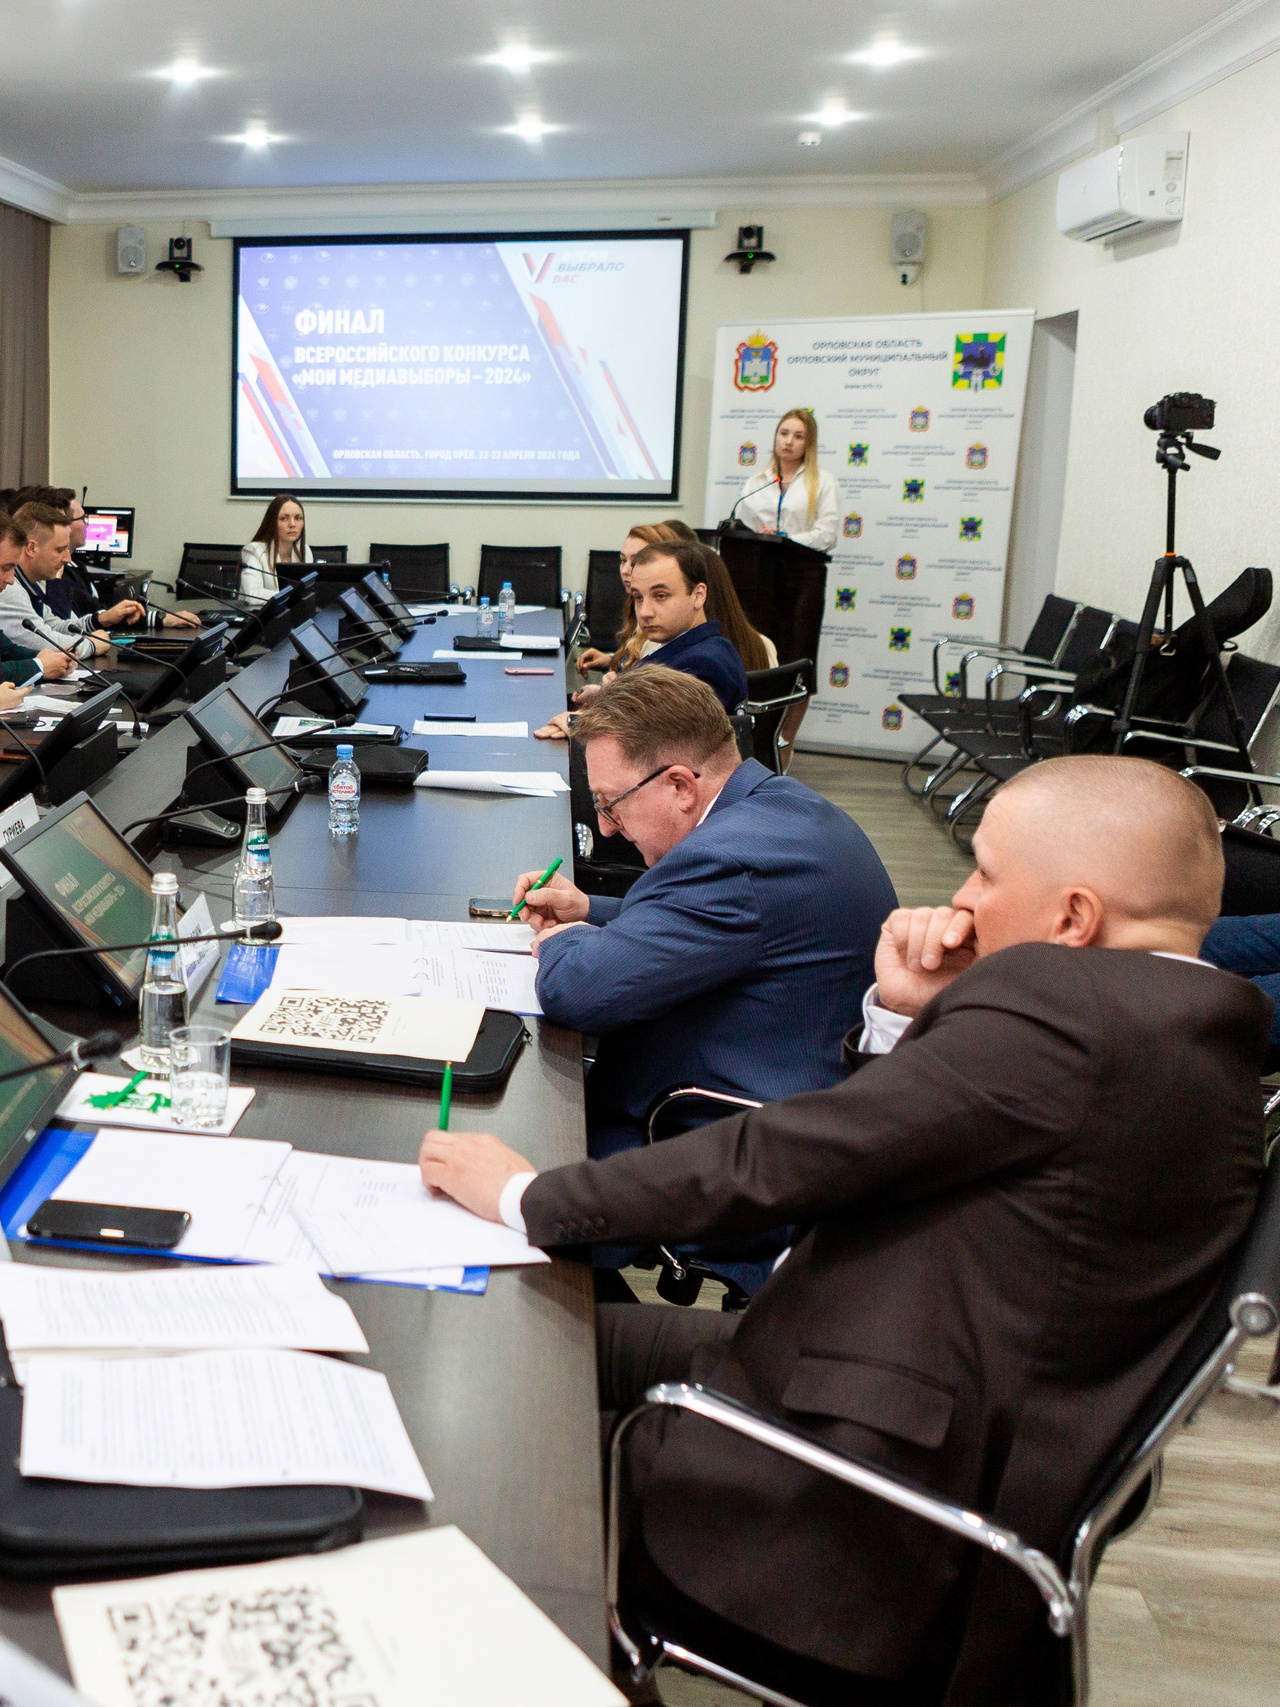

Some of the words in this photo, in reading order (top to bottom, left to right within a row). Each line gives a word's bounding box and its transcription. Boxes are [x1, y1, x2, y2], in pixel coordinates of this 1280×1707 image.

[557, 262, 625, 272] ВЫБРАЛО
[552, 274, 580, 284] ВАС
[294, 309, 385, 334] ФИНАЛ
[812, 340, 873, 350] ОРЛОВСКАЯ
[874, 339, 923, 349] ОБЛАСТЬ
[294, 343, 440, 364] ВСЕРОССИЙСКОГО
[443, 344, 531, 363] КОНКУРСА
[786, 353, 848, 364] ОРЛОВСКИЙ
[292, 369, 337, 386] «МОИ
[340, 368, 470, 388] МЕДИАВЫБОРЫ
[484, 368, 531, 385] 2024»
[848, 368, 881, 377] ОКРУГ
[333, 449, 382, 460] ОРЛОВСКАЯ
[557, 450, 580, 462] ГОДА
